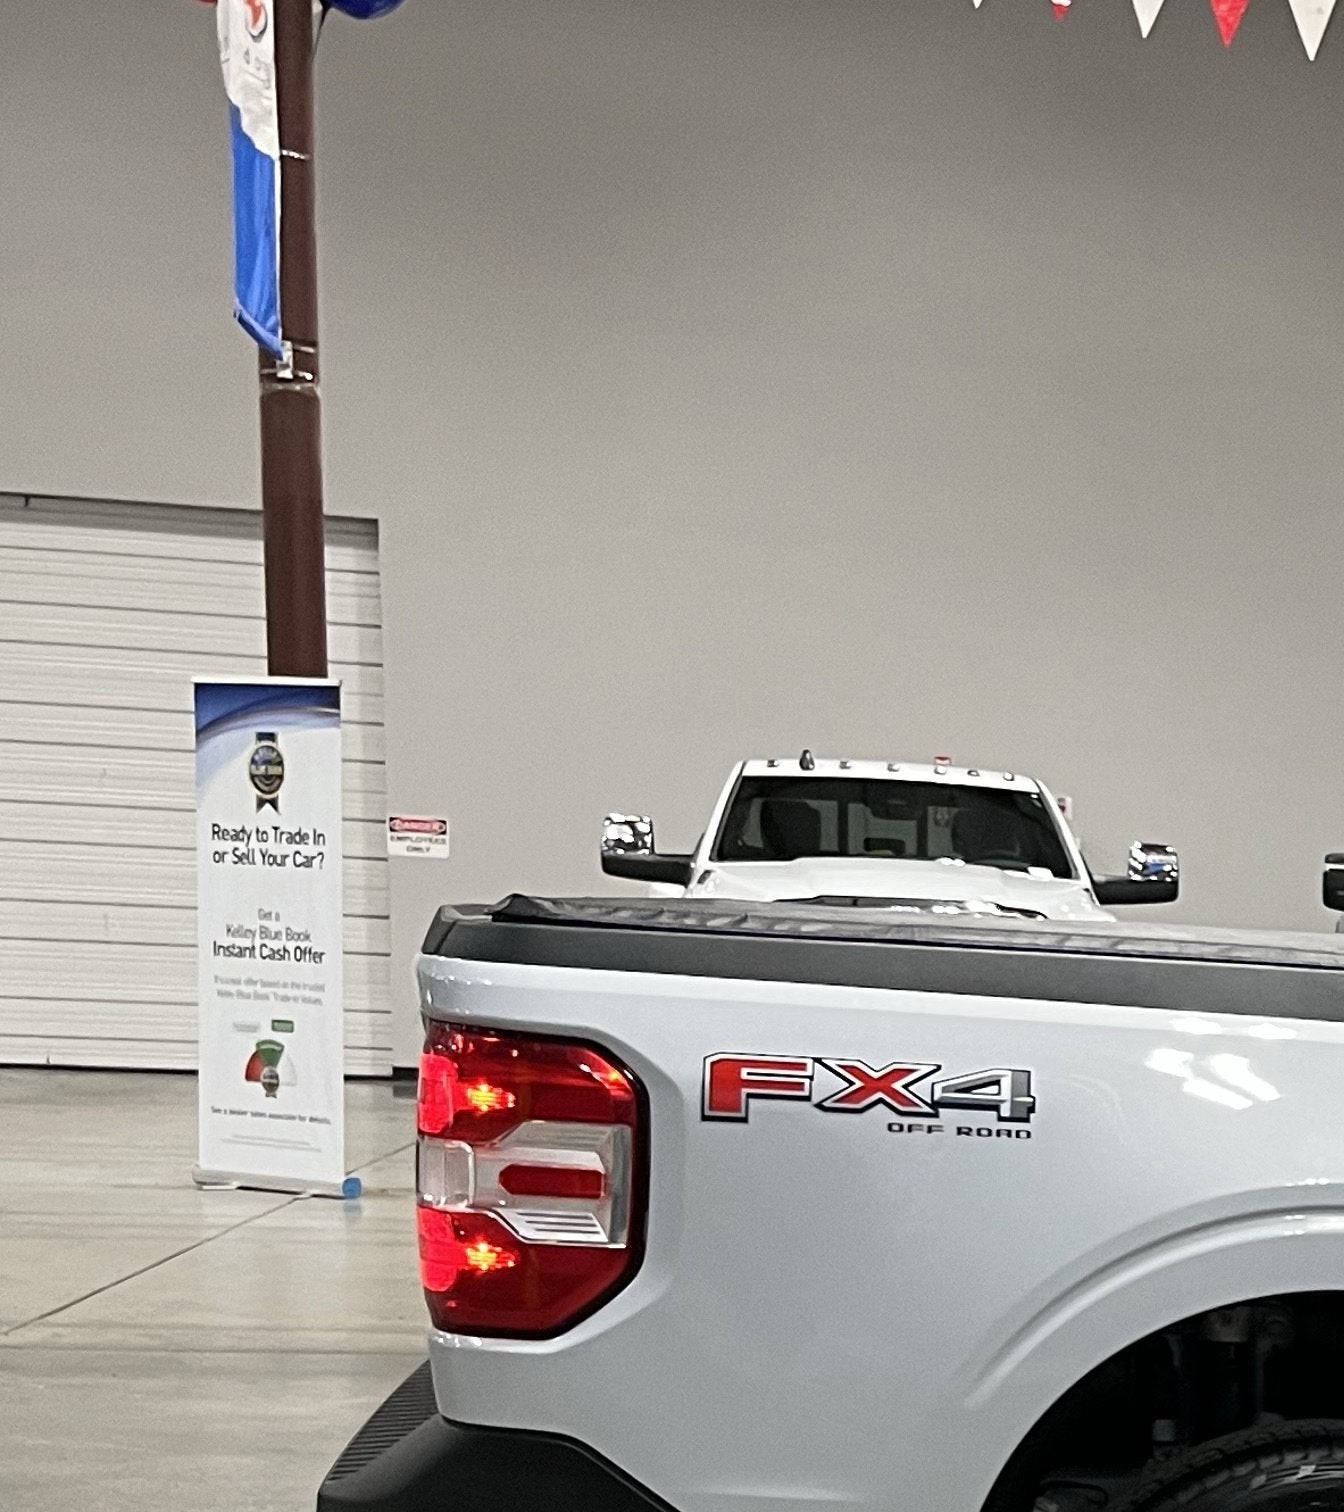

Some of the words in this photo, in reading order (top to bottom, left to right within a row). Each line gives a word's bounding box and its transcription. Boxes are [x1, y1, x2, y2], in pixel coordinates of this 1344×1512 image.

[211, 823, 253, 848] Ready
[256, 826, 269, 843] to
[272, 826, 310, 846] Trade
[313, 828, 326, 846] In
[213, 850, 229, 864] or
[232, 847, 256, 866] Sell
[259, 848, 290, 868] Your
[293, 850, 325, 870] Car?
[259, 925, 283, 941] Blue
[285, 926, 312, 942] Book
[213, 941, 257, 959] Instant
[259, 943, 291, 961] Cash
[294, 945, 326, 964] Offer
[701, 1051, 1036, 1123] FX4
[888, 1122, 945, 1134] OFF
[956, 1126, 1032, 1139] ROAD
